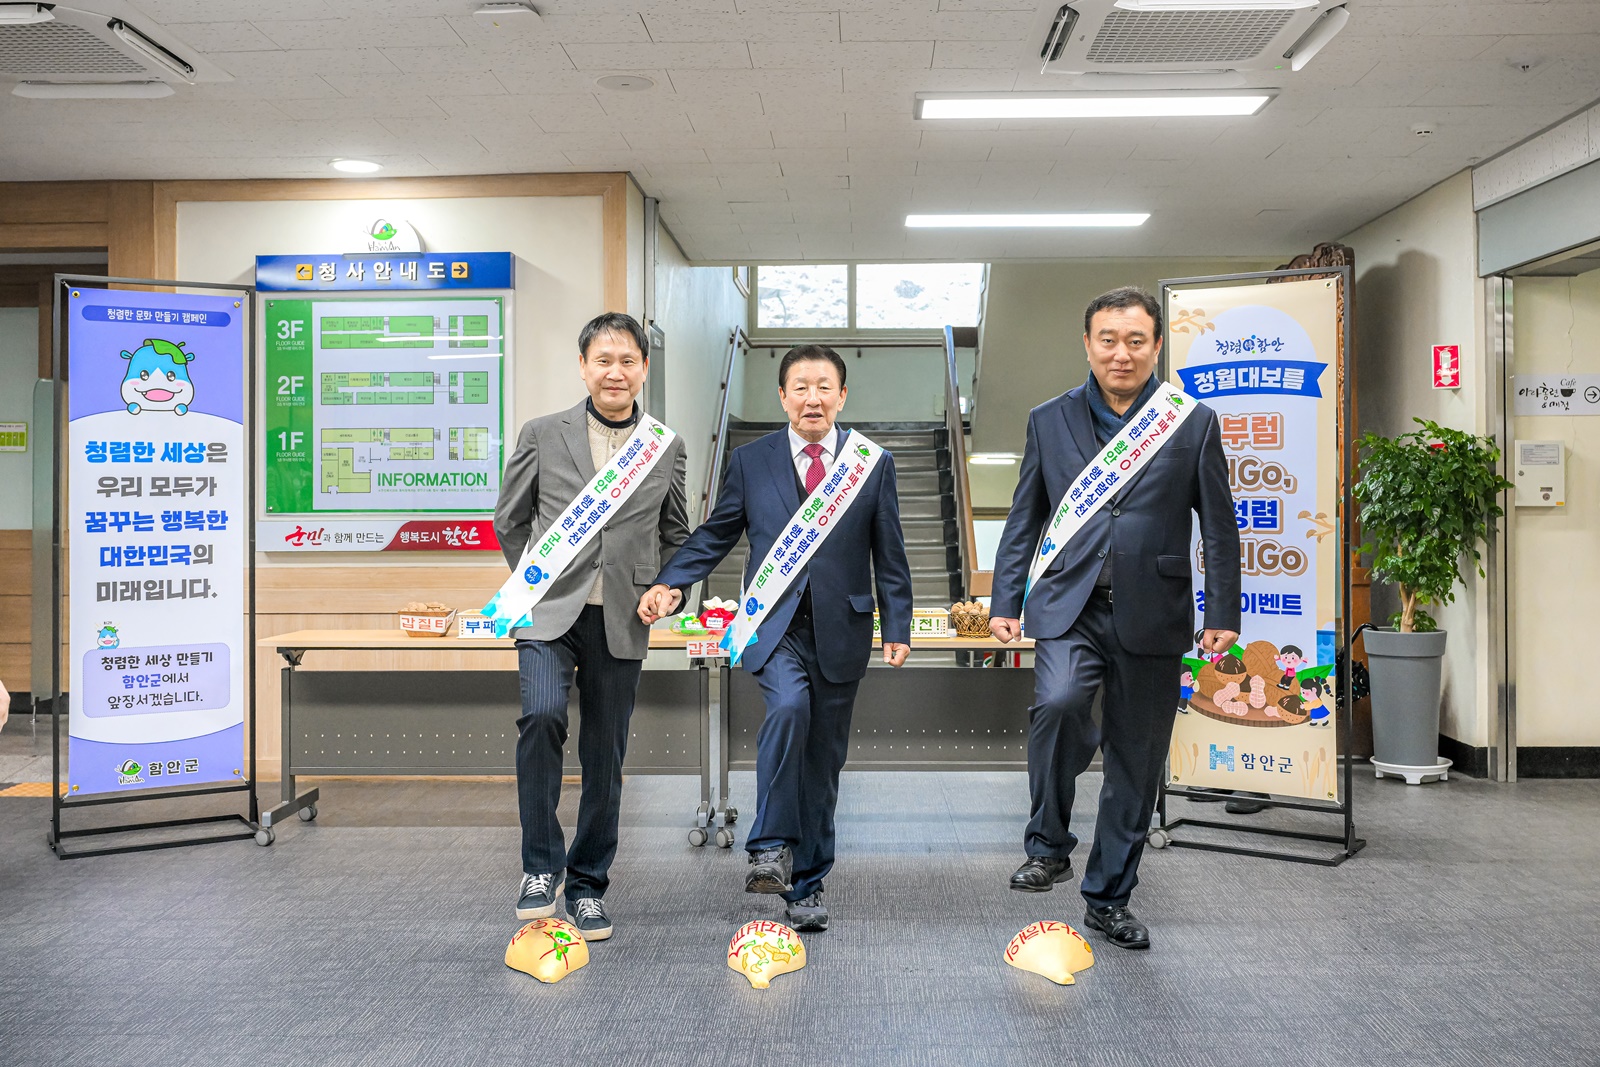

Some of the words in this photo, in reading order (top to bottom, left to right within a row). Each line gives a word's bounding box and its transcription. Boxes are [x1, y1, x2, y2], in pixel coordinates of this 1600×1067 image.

[107, 308, 133, 321] 청렴한
[136, 309, 153, 322] 문화
[154, 310, 179, 323] 만들기
[181, 311, 208, 325] 캠페인
[277, 320, 304, 339] 3F
[277, 375, 304, 395] 2F
[1193, 366, 1305, 394] 정월대보름
[1128, 407, 1160, 440] 청렴한
[1221, 415, 1278, 445] 부럼
[85, 441, 155, 463] 청렴한
[160, 441, 229, 463] 세상은
[278, 431, 304, 451] 1F
[617, 437, 644, 469] 청렴한
[1103, 440, 1129, 466] 함안
[1119, 410, 1177, 471] 부패ZERO
[377, 472, 488, 486] INFORMATION
[594, 469, 618, 494] 함안
[610, 440, 659, 498] 부패ZERO
[823, 462, 849, 497] 청렴한
[96, 476, 143, 498] 우리
[149, 475, 218, 498] 모두가
[818, 462, 865, 527] 부패ZERO
[1070, 465, 1104, 502] 행복한
[1074, 471, 1121, 518] 청렴실천
[85, 511, 155, 533] 꿈꾸는
[160, 509, 229, 532] 행복한
[561, 494, 595, 531] 행복한
[801, 497, 825, 523] 함안
[568, 499, 612, 547] 청렴실천
[334, 532, 353, 543] 함께
[356, 532, 384, 544] 만드는
[399, 530, 440, 544] 행복도시
[441, 526, 481, 547] 함안
[539, 531, 562, 558] 군민
[773, 523, 804, 562] 행복한
[99, 543, 215, 568] 대한민국의
[779, 527, 820, 576] 청렴실천
[756, 563, 774, 589] 군민
[96, 578, 218, 602] 미래입니다.
[1241, 592, 1303, 615] 이벤트
[101, 654, 140, 670] 청렴한
[145, 653, 172, 668] 세상
[177, 651, 213, 666] 만들기
[688, 641, 731, 656] 갑질
[122, 672, 190, 689] 함안군에서
[108, 691, 204, 710] 앞장서겠습니다.
[148, 759, 199, 776] 함안군
[1240, 752, 1294, 774] 함안군
